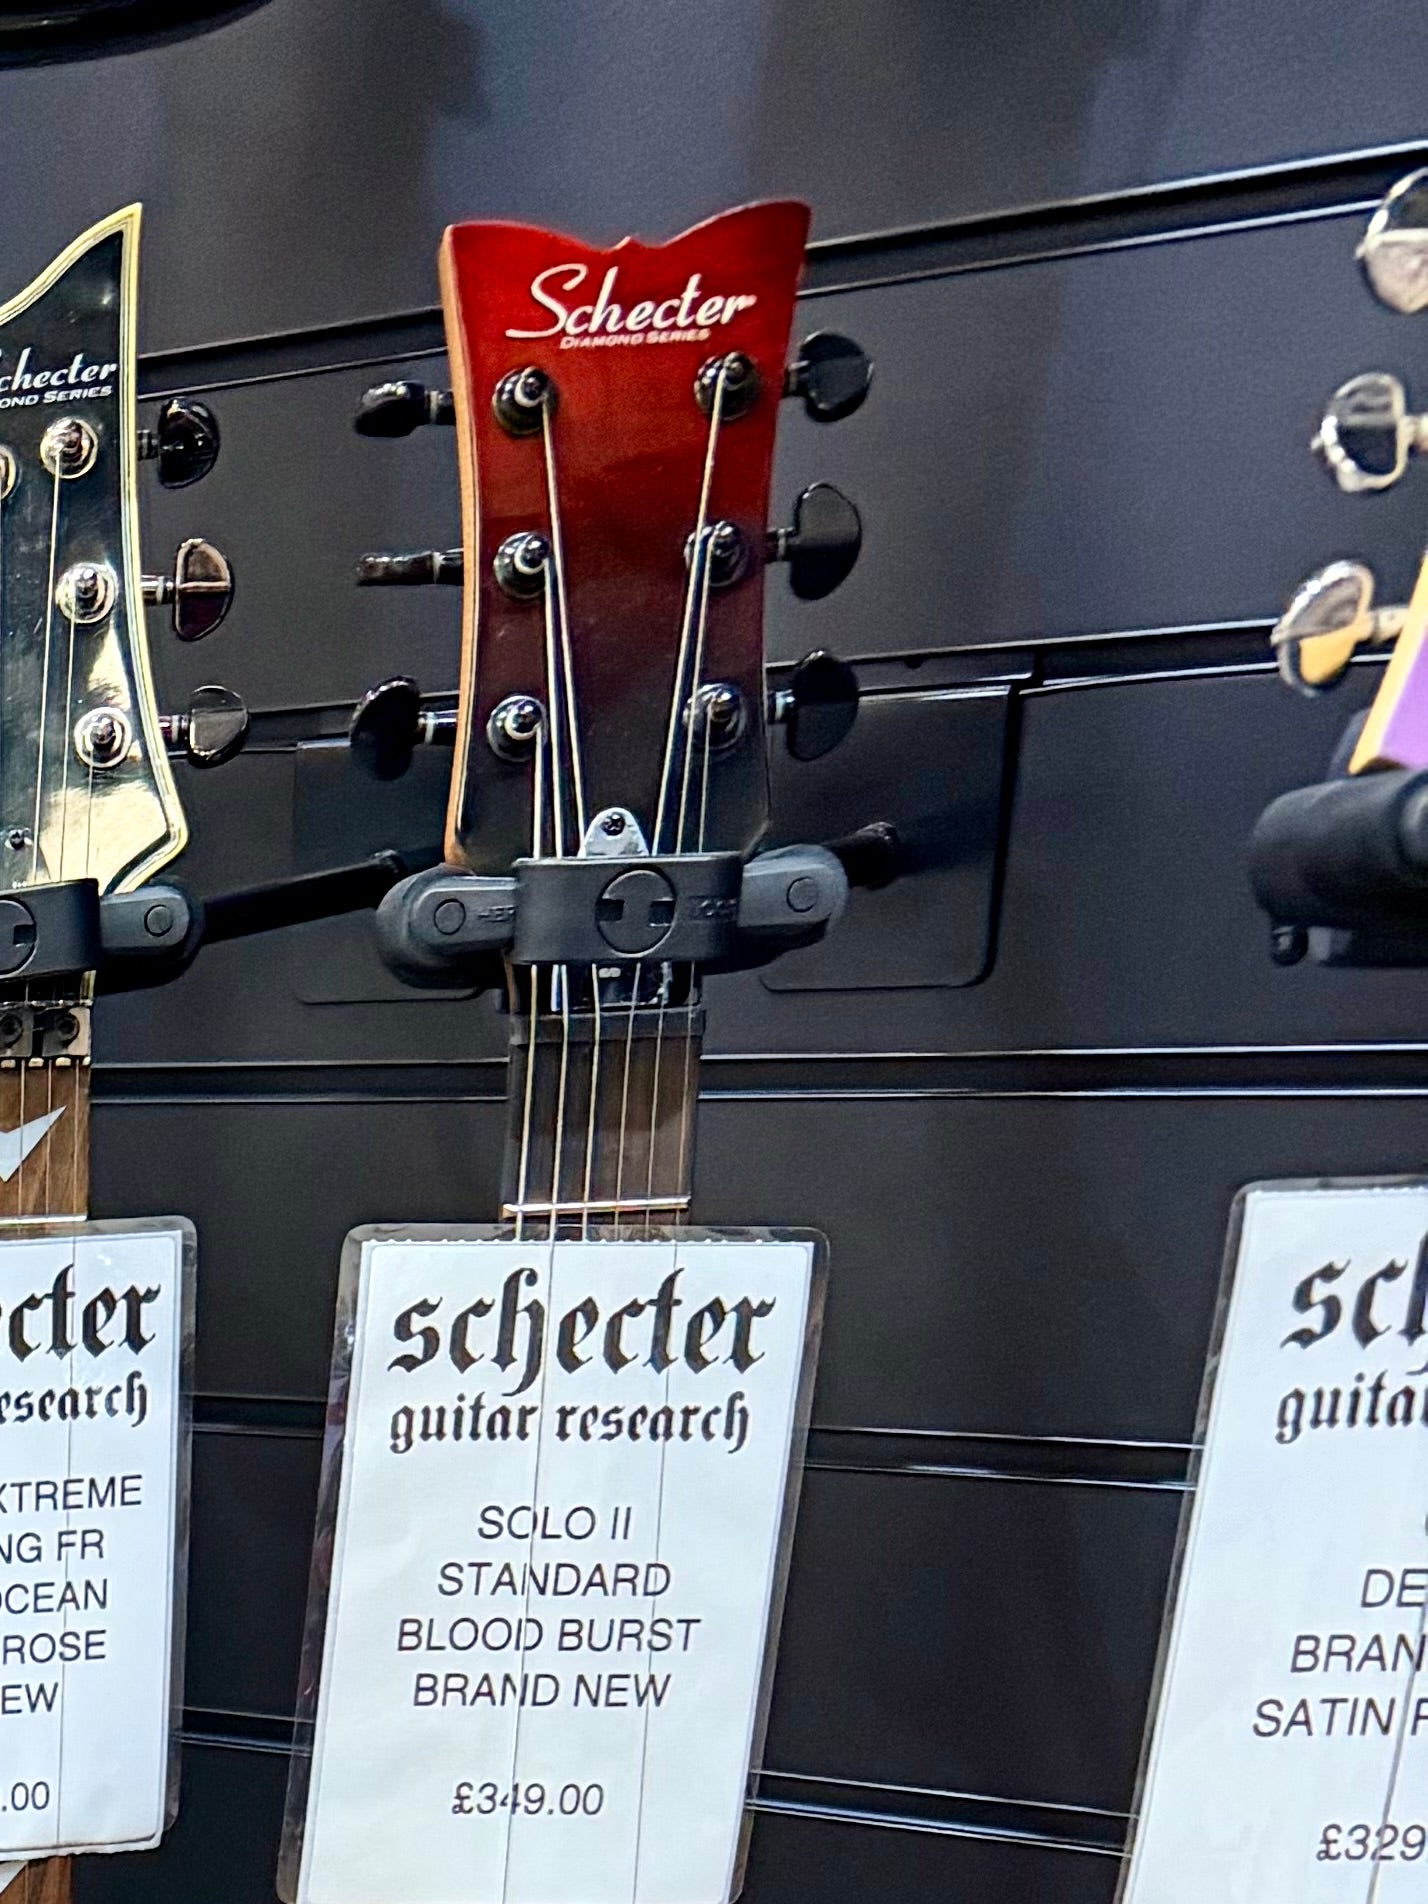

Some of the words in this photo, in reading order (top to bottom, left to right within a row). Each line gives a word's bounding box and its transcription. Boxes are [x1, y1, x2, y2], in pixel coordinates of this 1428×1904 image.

[505, 263, 757, 339] Schecter
[44, 386, 113, 403] SERIES
[388, 1267, 776, 1397] schecter
[389, 1392, 539, 1454] guitar
[555, 1391, 751, 1454] research
[477, 1506, 597, 1541] SOLO
[611, 1506, 633, 1541] II
[57, 1529, 106, 1562] FR
[438, 1562, 672, 1598] STANDARD
[2, 1630, 108, 1665] ROSE
[397, 1618, 545, 1652] BLOOD
[557, 1618, 703, 1652] BURST
[412, 1673, 560, 1707] BRAND
[573, 1673, 673, 1707] NEW
[1253, 1697, 1396, 1737] SATIN
[451, 1781, 605, 1817] £349.00
